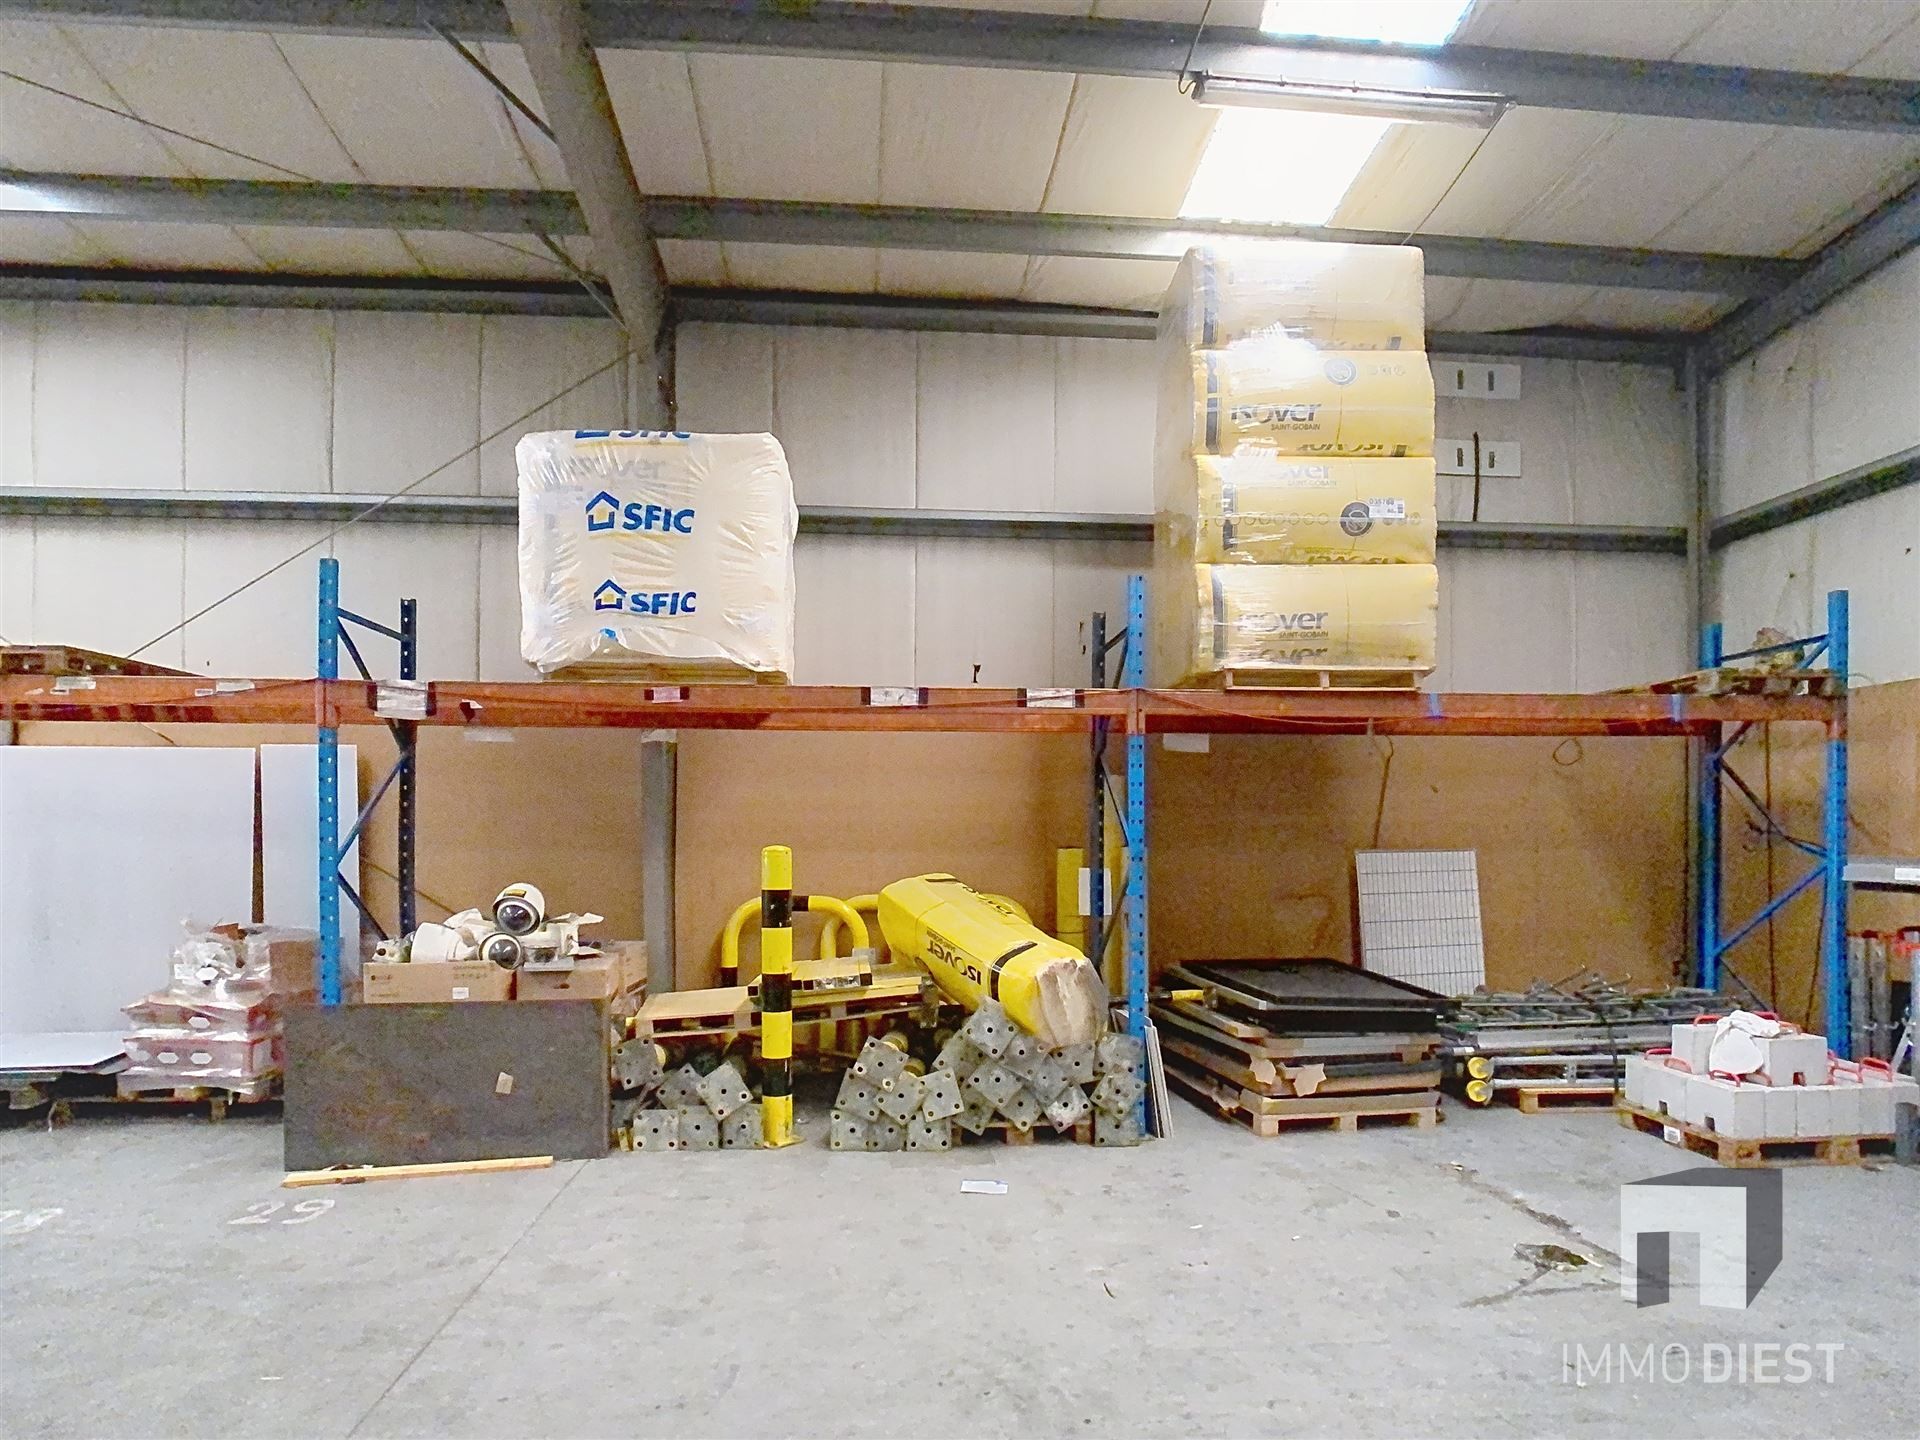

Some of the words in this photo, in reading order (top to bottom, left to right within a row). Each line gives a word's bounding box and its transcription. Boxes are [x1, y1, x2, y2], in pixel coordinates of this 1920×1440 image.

[622, 502, 695, 533] SFIC
[630, 591, 697, 615] SFIC
[226, 1199, 335, 1225] 29
